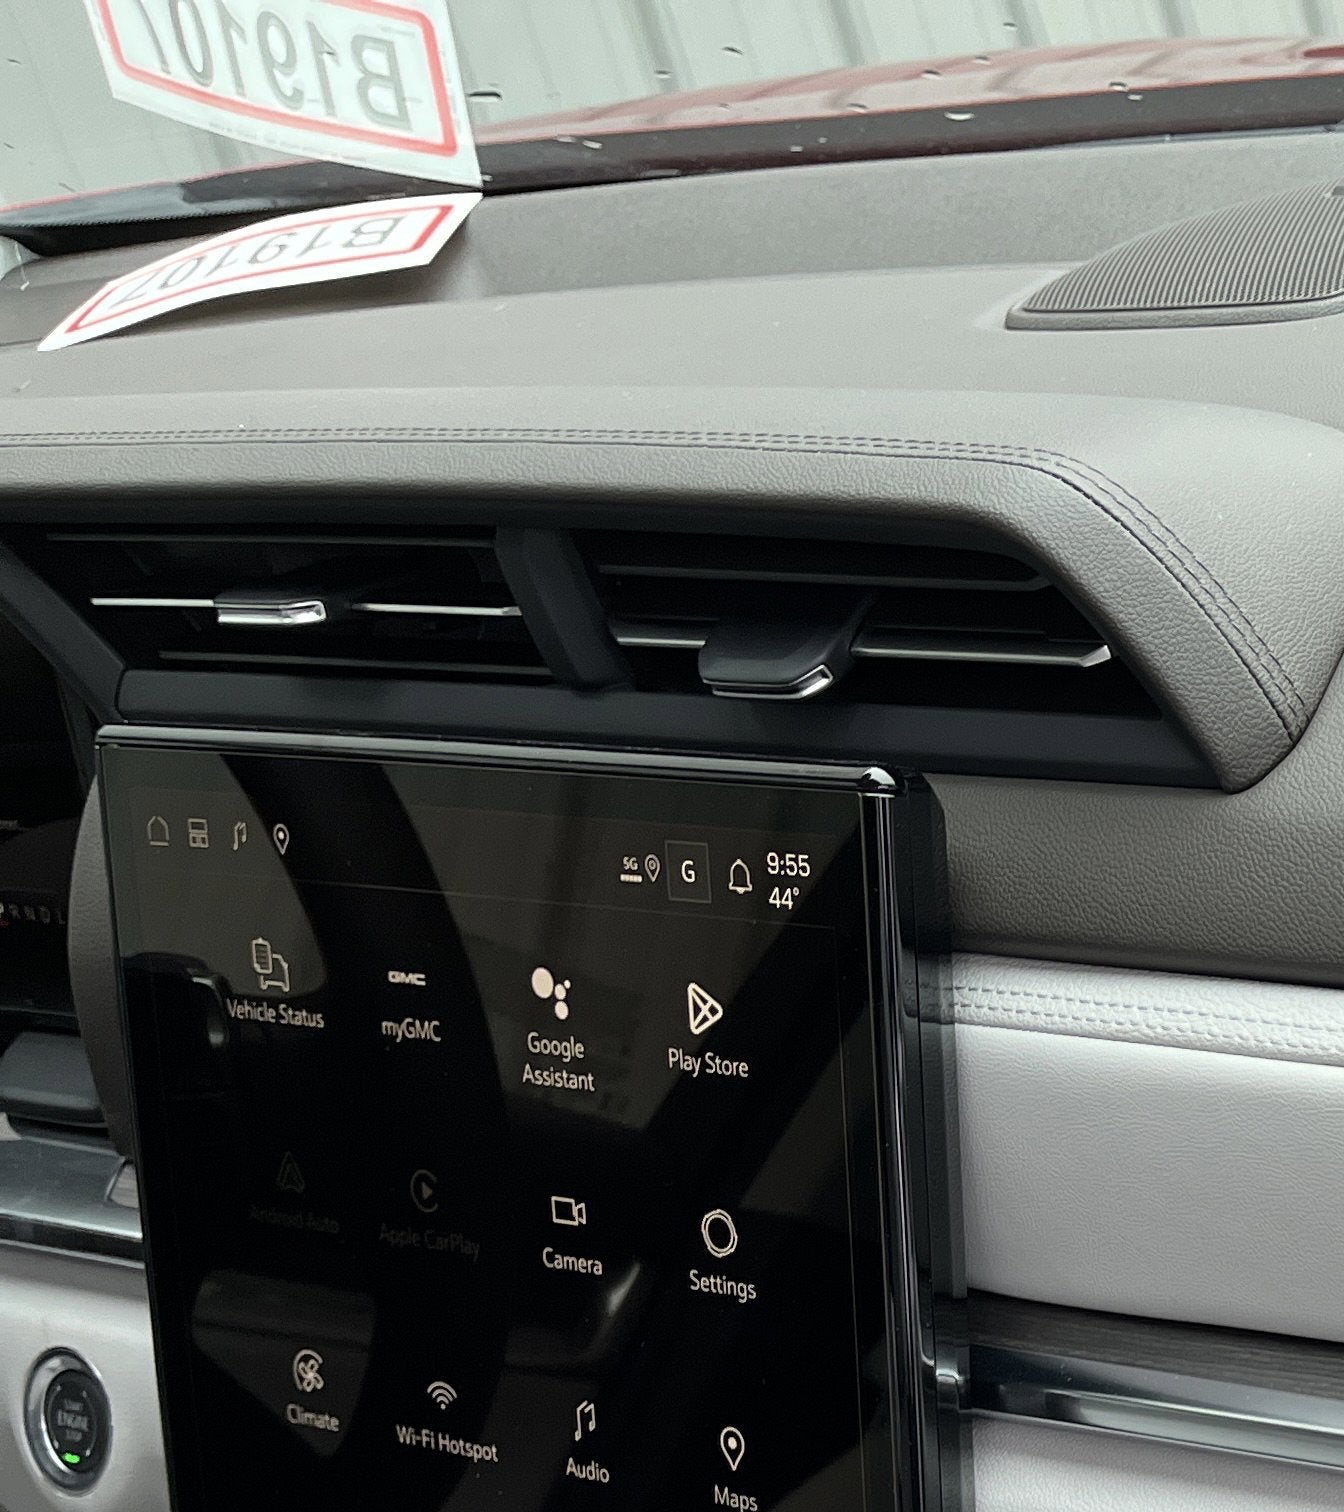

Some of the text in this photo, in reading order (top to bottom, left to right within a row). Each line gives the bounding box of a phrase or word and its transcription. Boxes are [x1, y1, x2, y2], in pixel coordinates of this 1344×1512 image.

[105, 216, 407, 311] B19107
[622, 856, 638, 870] 5G
[681, 859, 696, 883] G
[766, 852, 811, 877] 9:55
[768, 887, 800, 910] 44°
[388, 970, 426, 986] GMC
[226, 999, 325, 1029] Vehicle Status
[381, 1018, 441, 1043] myGMC
[527, 1032, 585, 1063] Google
[522, 1063, 596, 1092] Assistant
[668, 1048, 749, 1078] Play Store
[542, 1247, 603, 1276] Camera
[689, 1269, 757, 1304] Settings
[286, 1403, 340, 1432] Climate
[396, 1424, 499, 1463] Wi-Fi Hotspot
[565, 1457, 610, 1483] Audio
